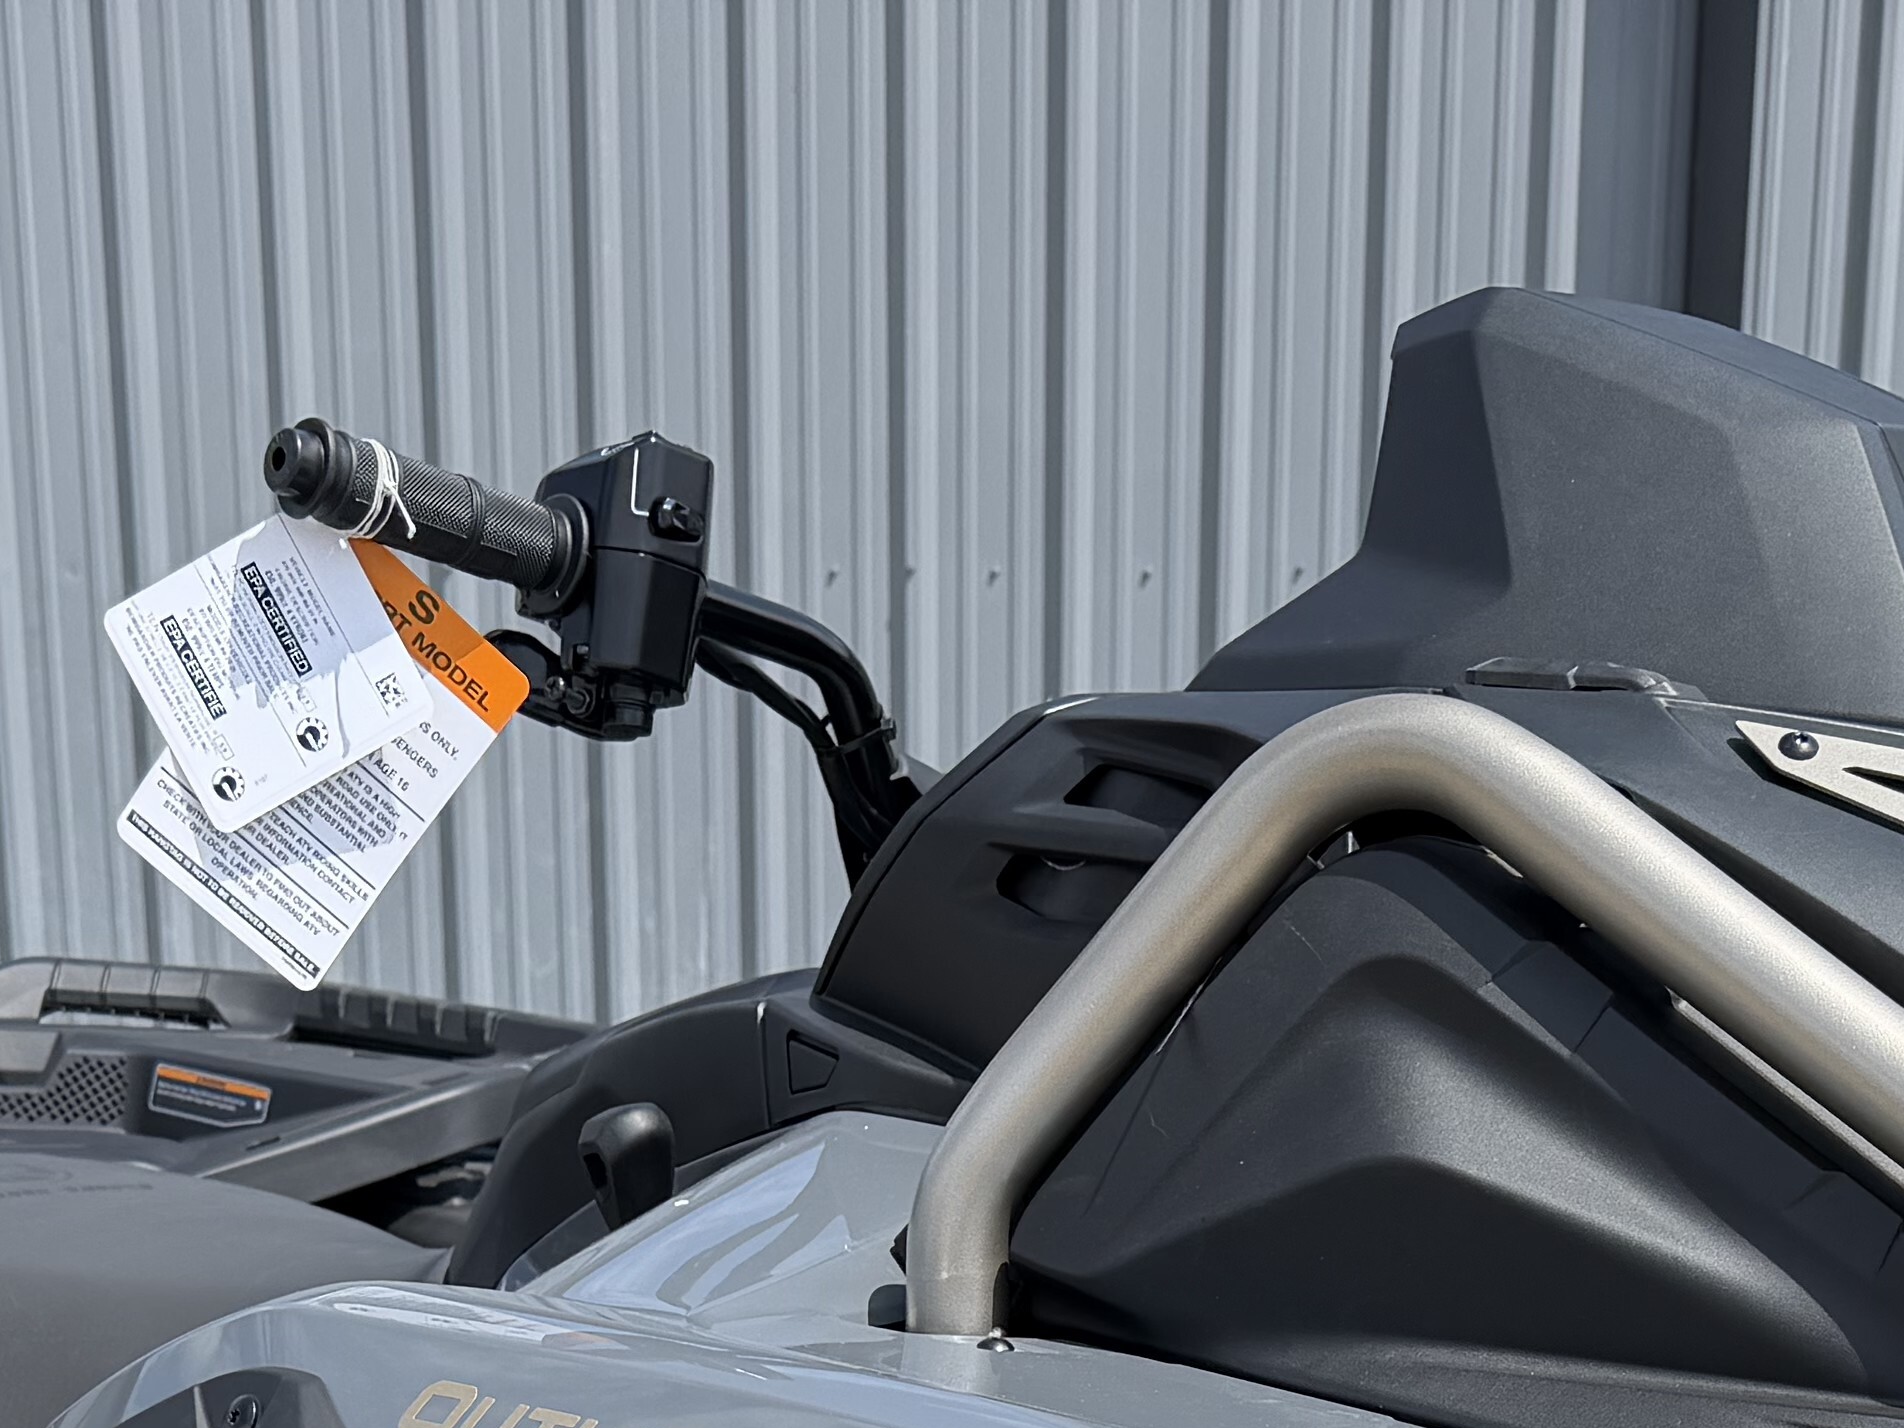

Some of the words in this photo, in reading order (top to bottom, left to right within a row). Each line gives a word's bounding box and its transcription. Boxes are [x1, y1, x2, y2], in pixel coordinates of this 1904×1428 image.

[161, 617, 189, 652] EPA
[242, 564, 268, 598] EPA
[259, 594, 310, 674] CERTIFIED
[406, 630, 499, 713] MODEL
[427, 729, 462, 761] ONLY.
